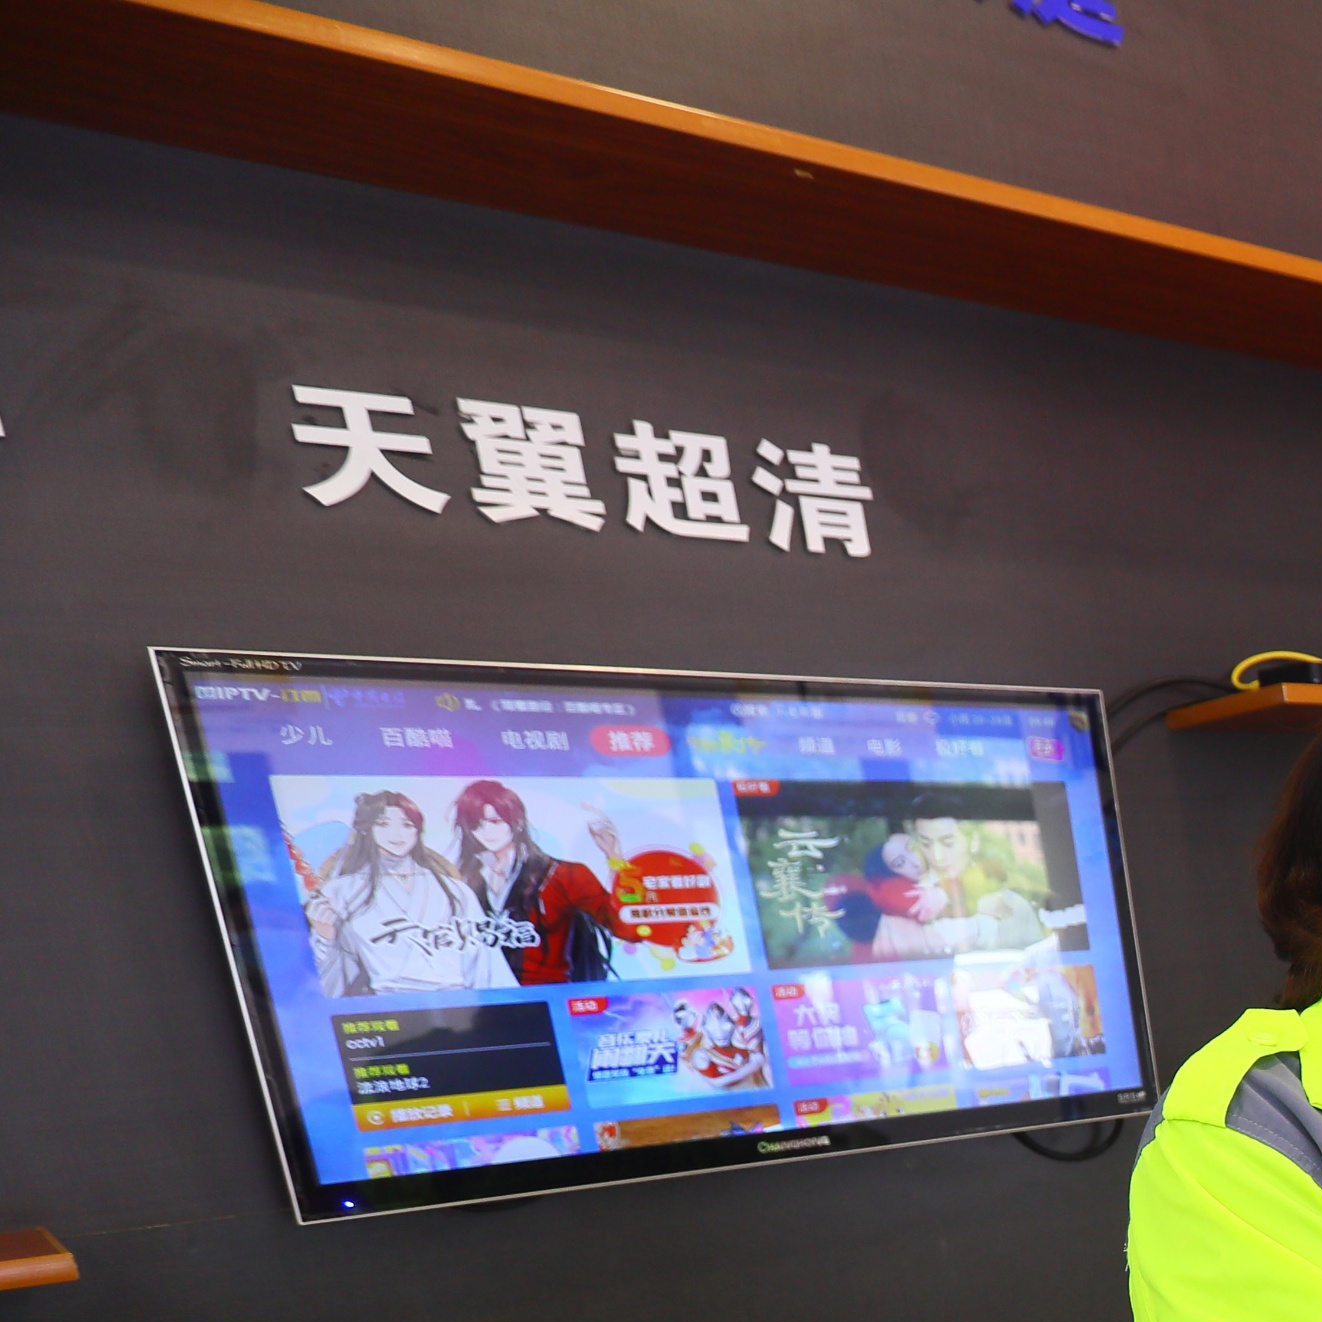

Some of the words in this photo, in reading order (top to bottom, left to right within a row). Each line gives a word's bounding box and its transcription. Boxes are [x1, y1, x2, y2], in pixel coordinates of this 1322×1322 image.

[290, 383, 873, 558] 天翼超清
[279, 723, 333, 746] 少儿
[500, 729, 570, 752] 电视剧
[607, 729, 655, 752] 推荐
